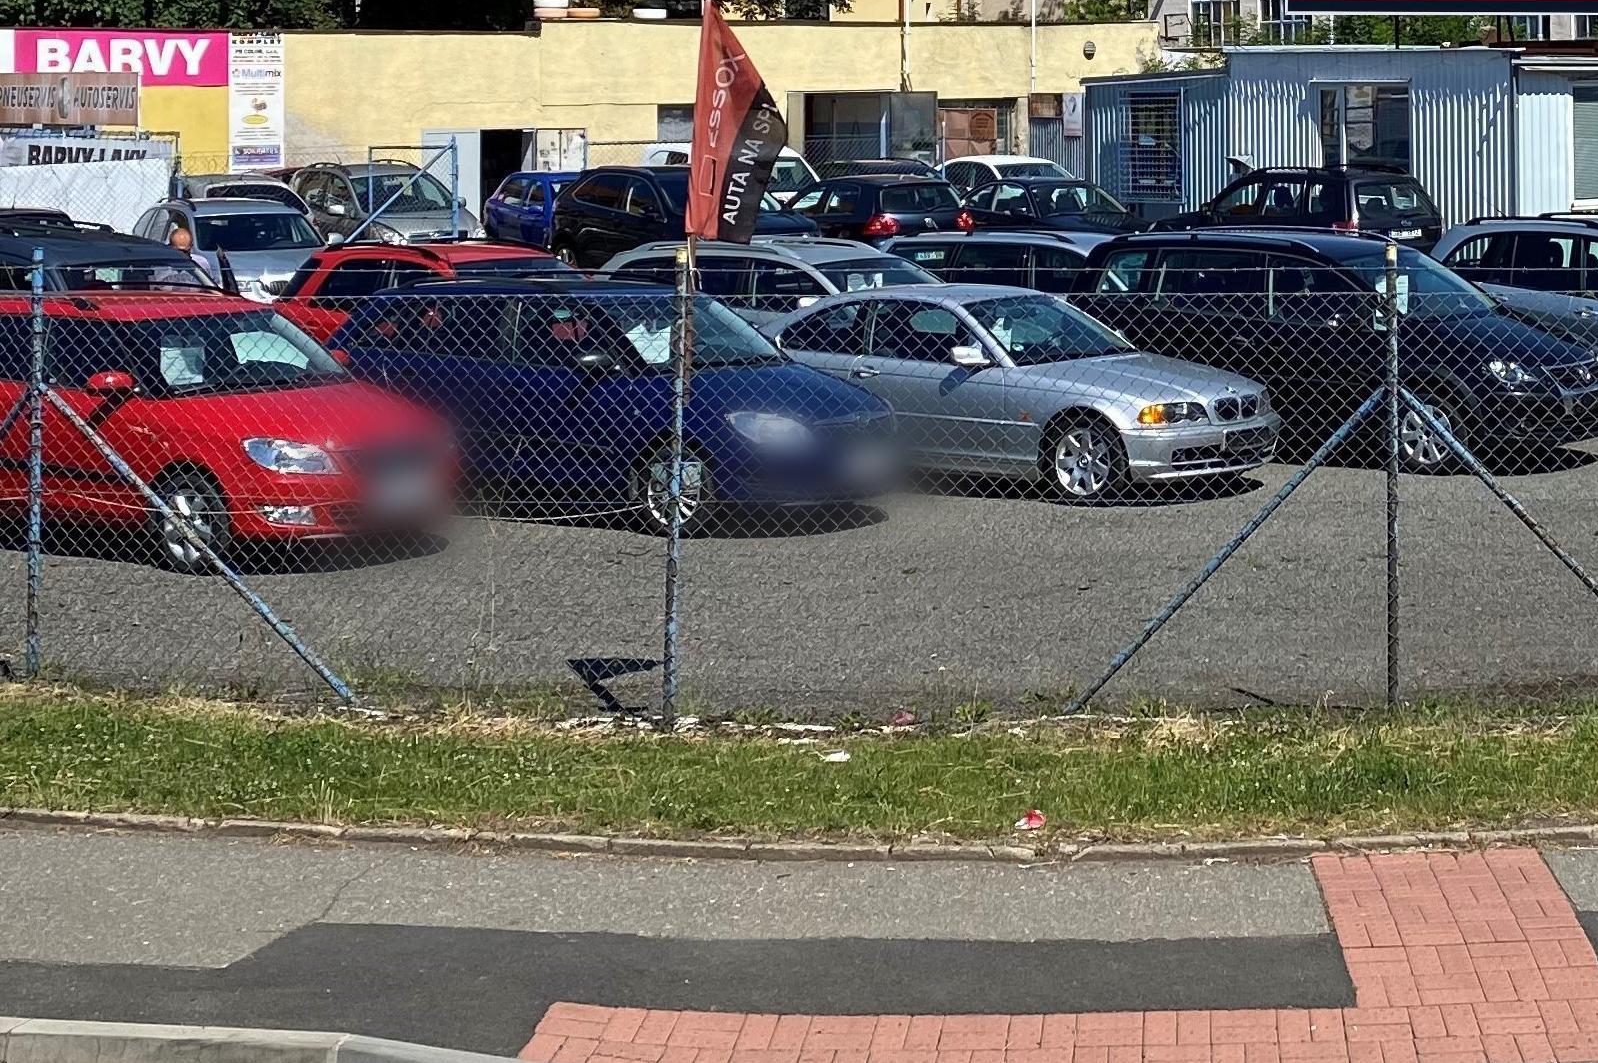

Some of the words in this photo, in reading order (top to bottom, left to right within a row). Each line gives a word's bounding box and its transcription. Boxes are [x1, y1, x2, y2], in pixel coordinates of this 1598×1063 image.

[36, 37, 210, 77] BARVY
[241, 68, 282, 78] Multimix
[73, 85, 137, 109] AUTOSERVIS
[709, 48, 746, 148] ESSOX
[722, 172, 751, 225] AUTA
[738, 139, 764, 166] NA
